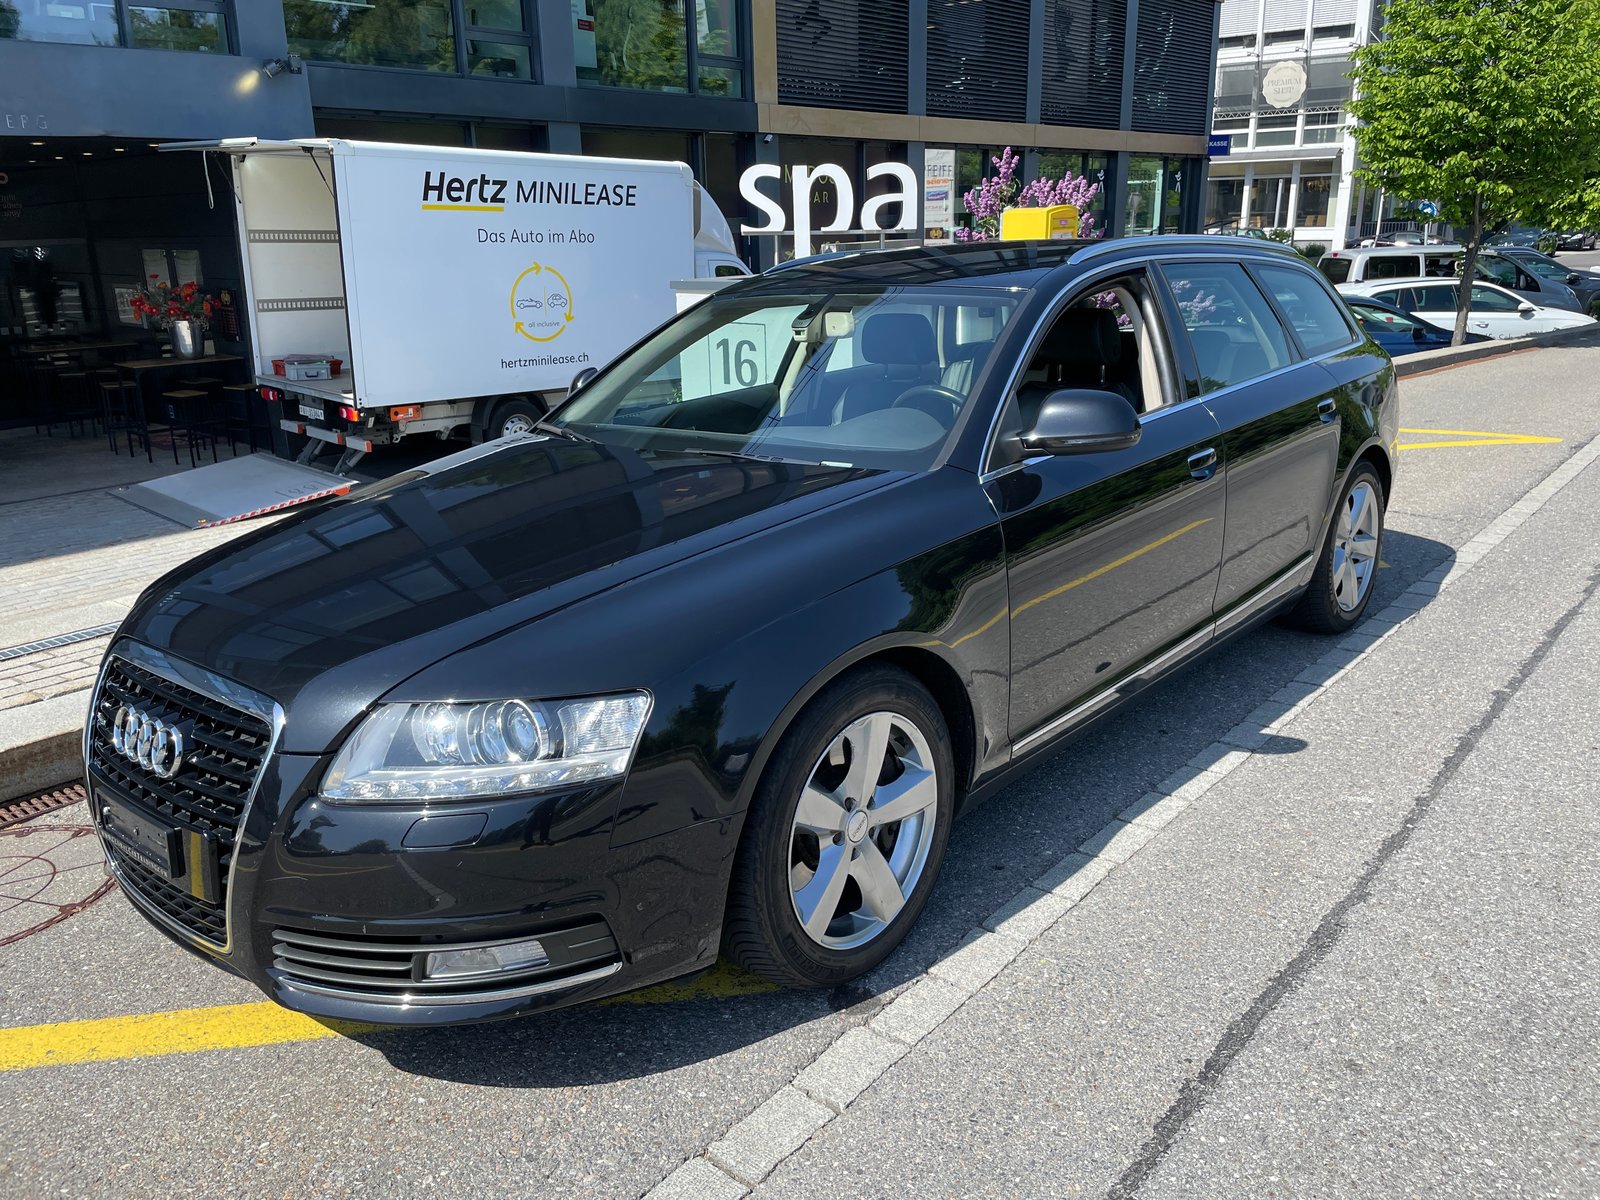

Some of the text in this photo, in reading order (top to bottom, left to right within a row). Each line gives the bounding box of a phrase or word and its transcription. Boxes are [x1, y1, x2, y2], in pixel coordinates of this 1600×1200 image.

[1267, 78, 1302, 87] PREMIUM
[422, 171, 637, 206] Hertz MINILEASE
[738, 161, 918, 260] spa
[477, 228, 595, 244] Das Auto im Abo
[537, 320, 560, 328] inclusive
[501, 352, 589, 369] hertzminilease.ch
[716, 337, 759, 387] 16
